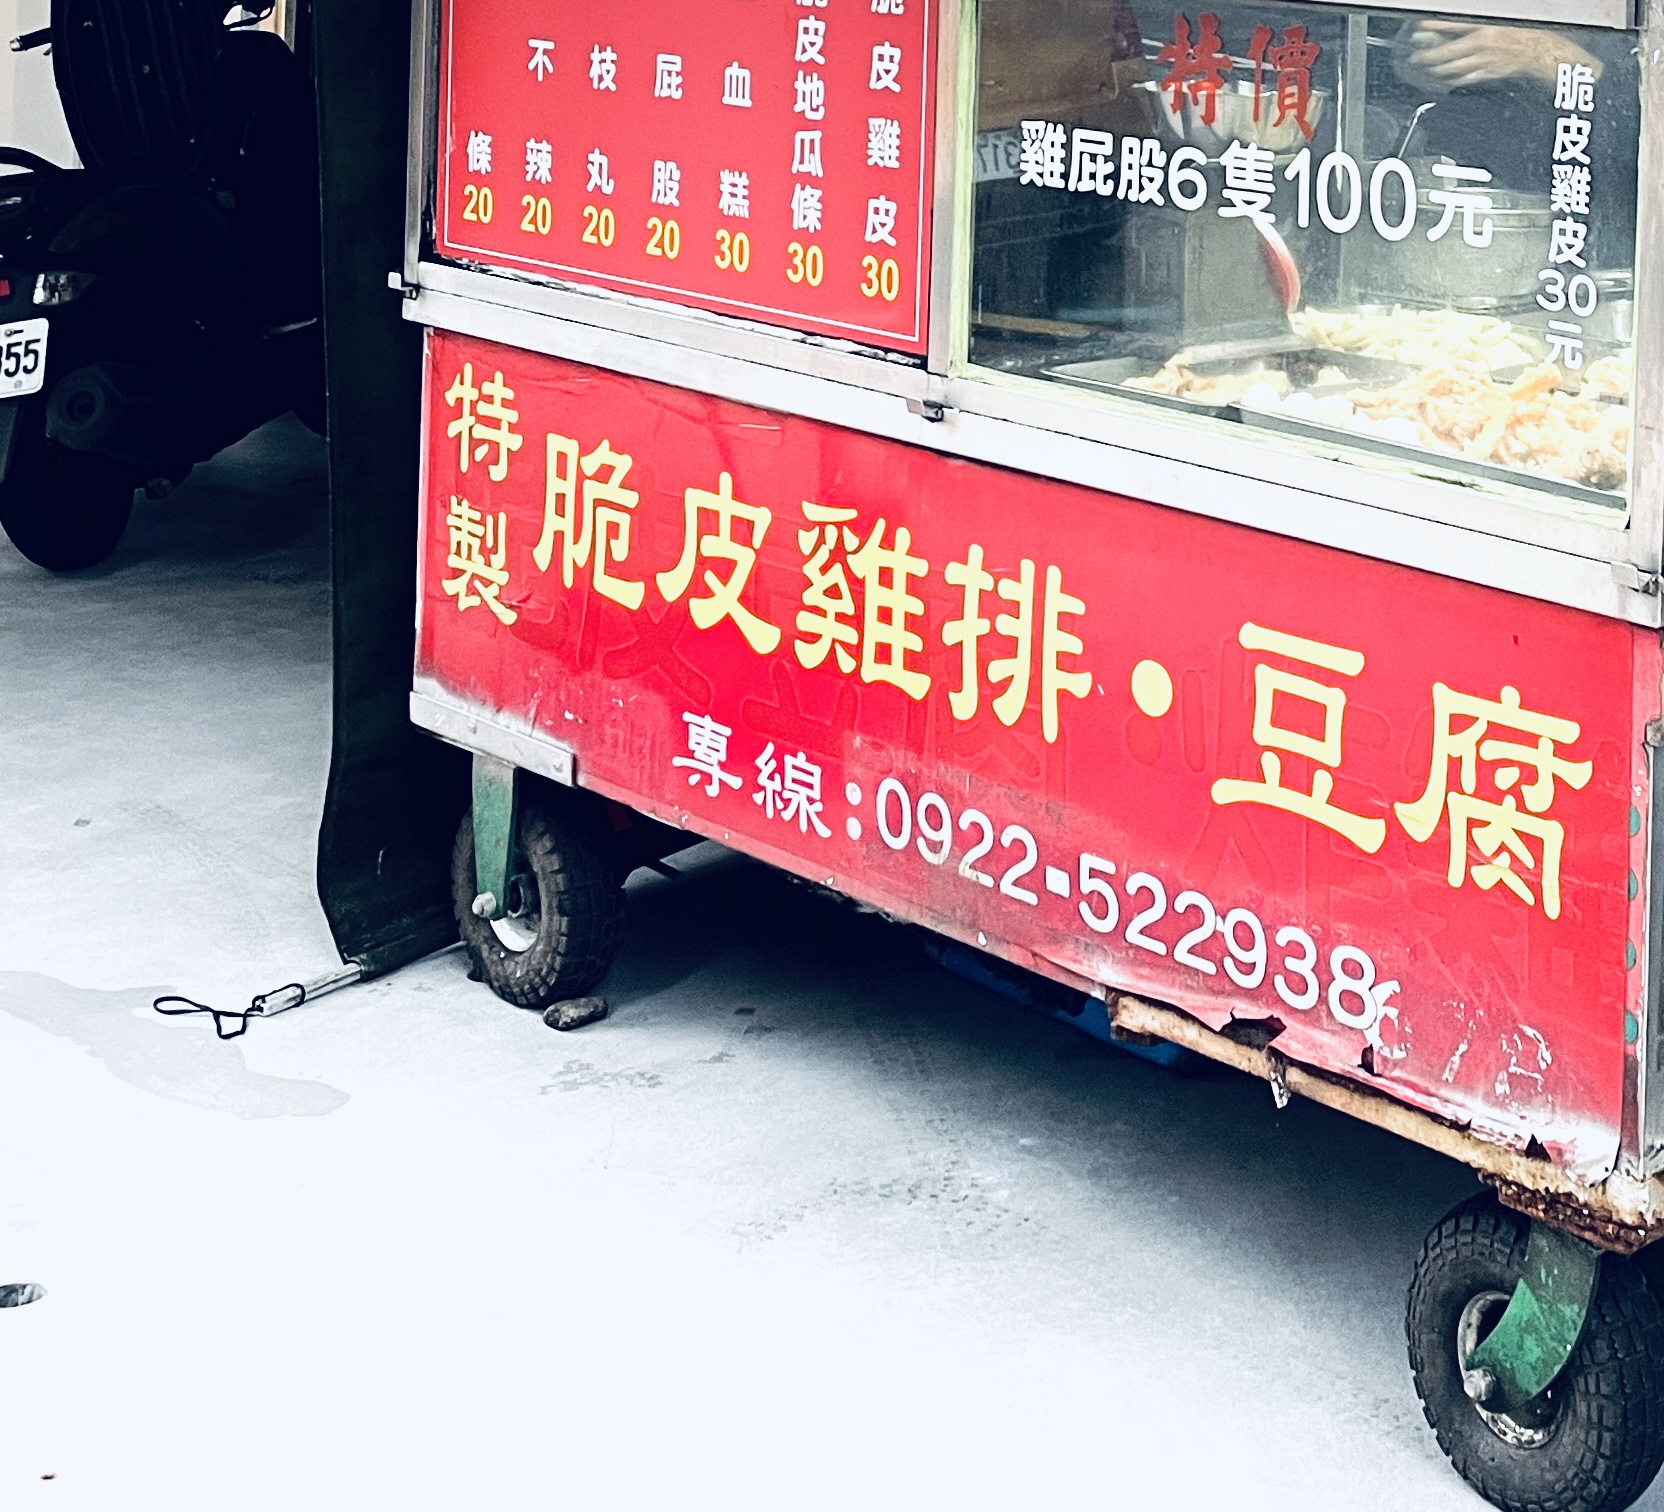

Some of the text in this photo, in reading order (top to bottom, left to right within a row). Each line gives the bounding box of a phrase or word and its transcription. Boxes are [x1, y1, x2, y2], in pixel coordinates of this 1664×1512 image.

[1155, 11, 1323, 142] 特價
[462, 184, 494, 225] 20
[520, 194, 553, 236] 20
[582, 205, 616, 248] 20
[646, 216, 681, 261] 20
[714, 229, 751, 274] 30
[786, 242, 825, 288] 30
[860, 255, 900, 302] 30
[0, 337, 41, 378] 55
[442, 362, 523, 626] 特製
